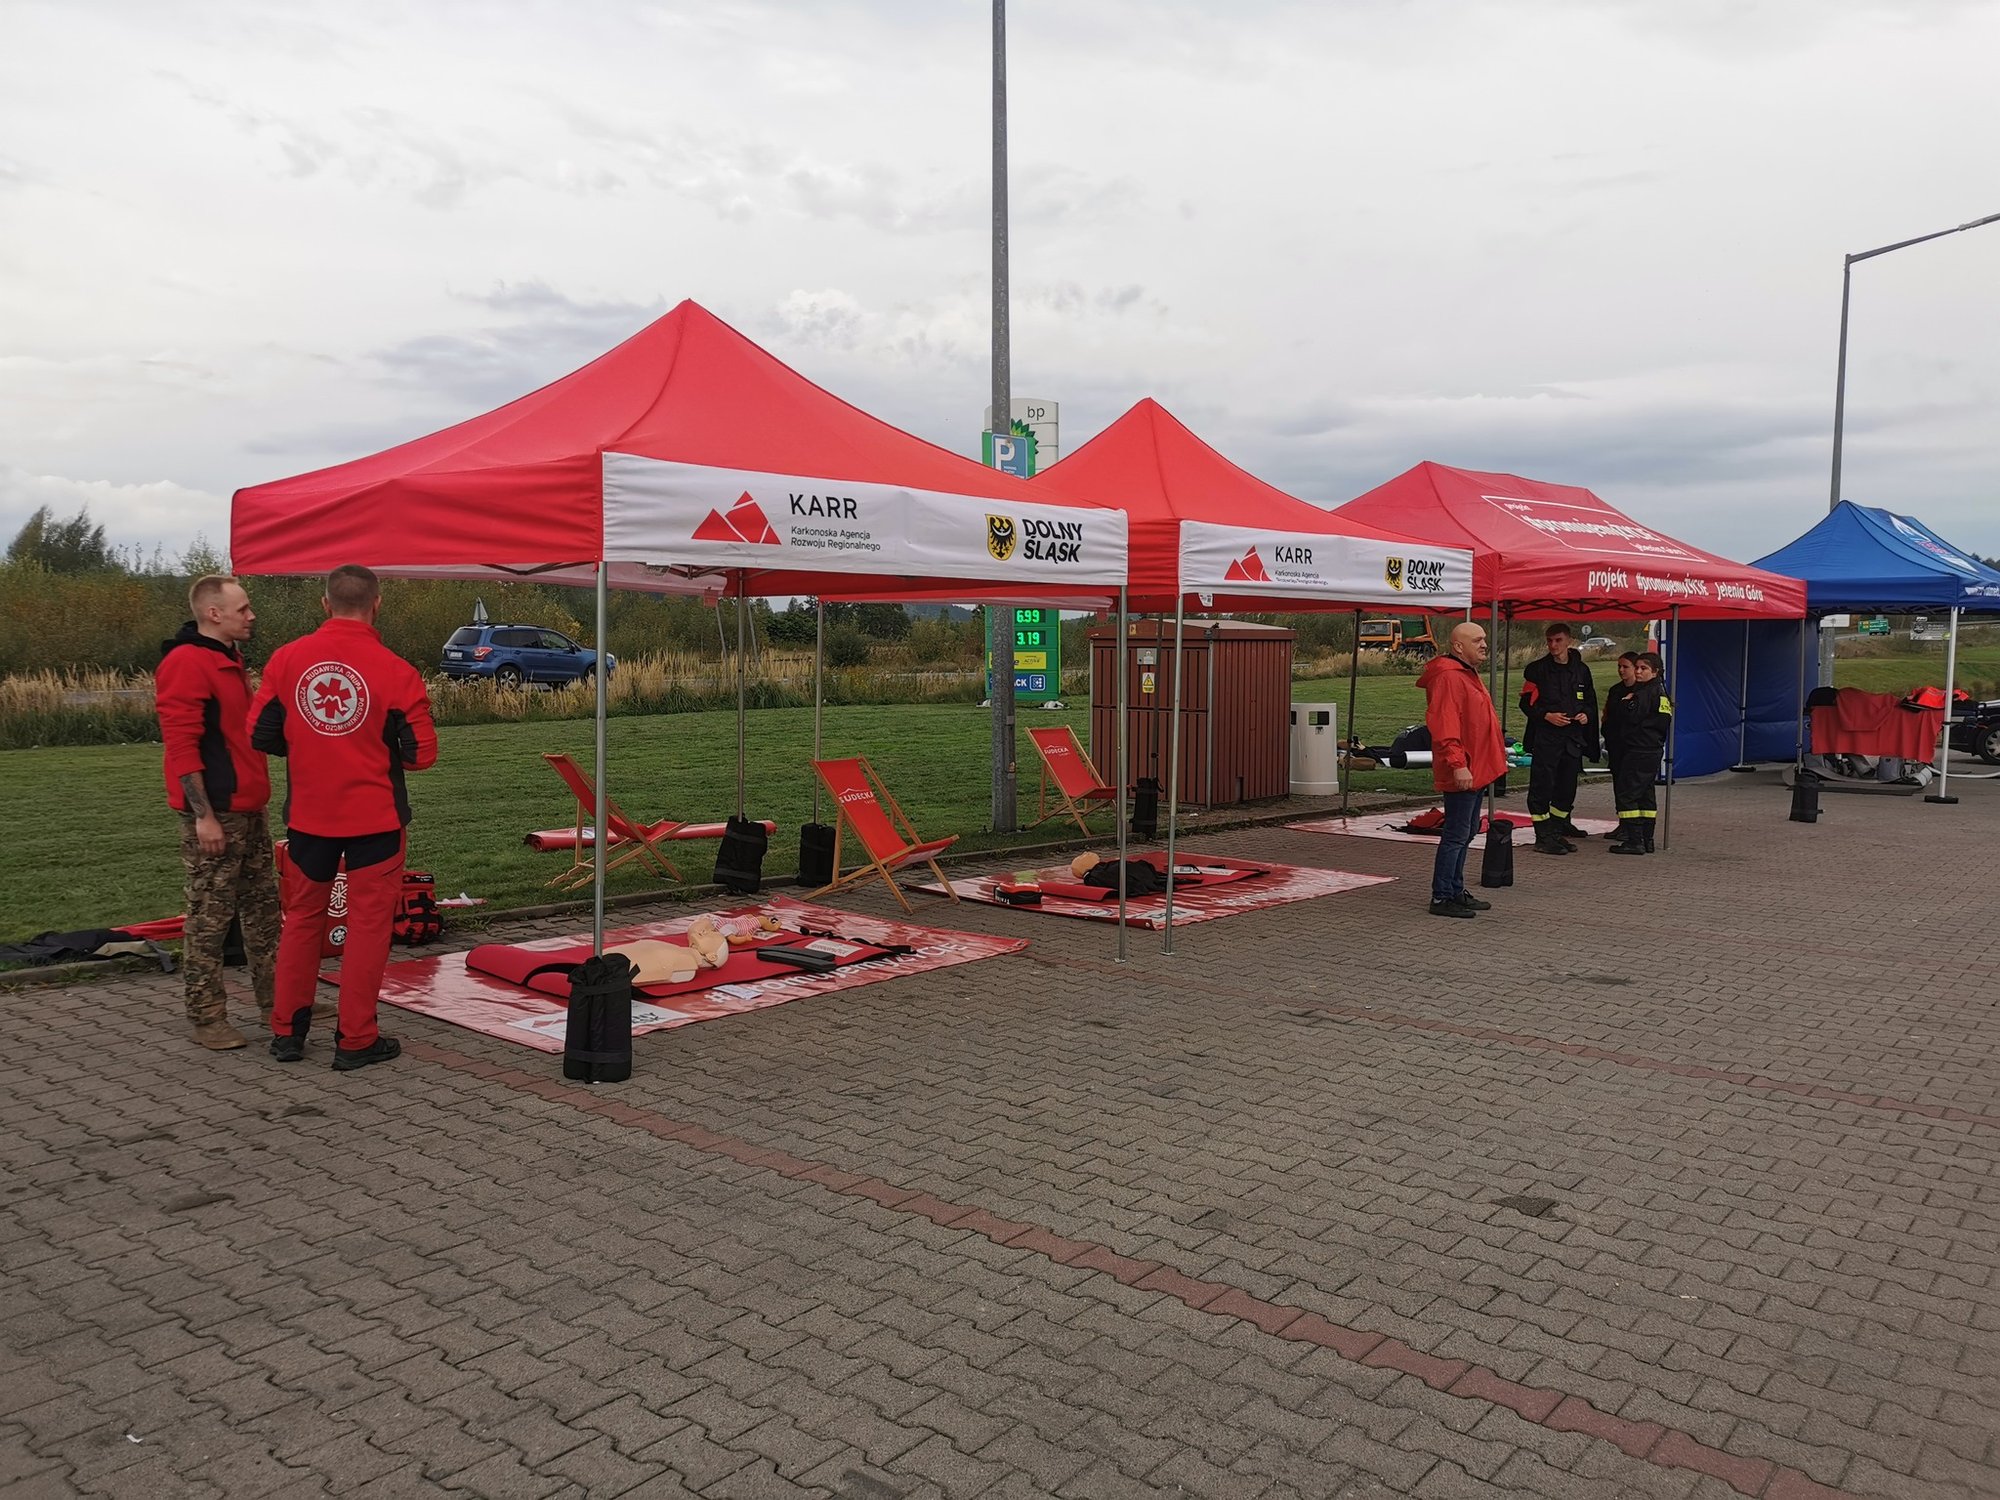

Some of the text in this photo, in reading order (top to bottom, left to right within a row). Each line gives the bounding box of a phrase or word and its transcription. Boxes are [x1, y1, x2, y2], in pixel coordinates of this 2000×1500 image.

[1027, 406, 1045, 421] bp
[995, 438, 1015, 471] P
[789, 493, 858, 520] KARR
[791, 526, 871, 541] Karkonoska Agencja
[1022, 518, 1082, 541] DOLNY
[791, 537, 881, 552] Rozwoju Regionalnego
[1023, 535, 1081, 564] ŚLĄSK
[1275, 546, 1313, 565] KARR
[1407, 558, 1445, 576] DOLNY
[1407, 572, 1445, 593] ŚLĄSK
[1588, 566, 1629, 593] projekt
[1714, 581, 1745, 601] Jelenia
[1745, 584, 1764, 602] Góra
[1016, 631, 1041, 646] 3.19
[305, 665, 344, 681] RUDAWSKA
[345, 671, 362, 691] GRUPA
